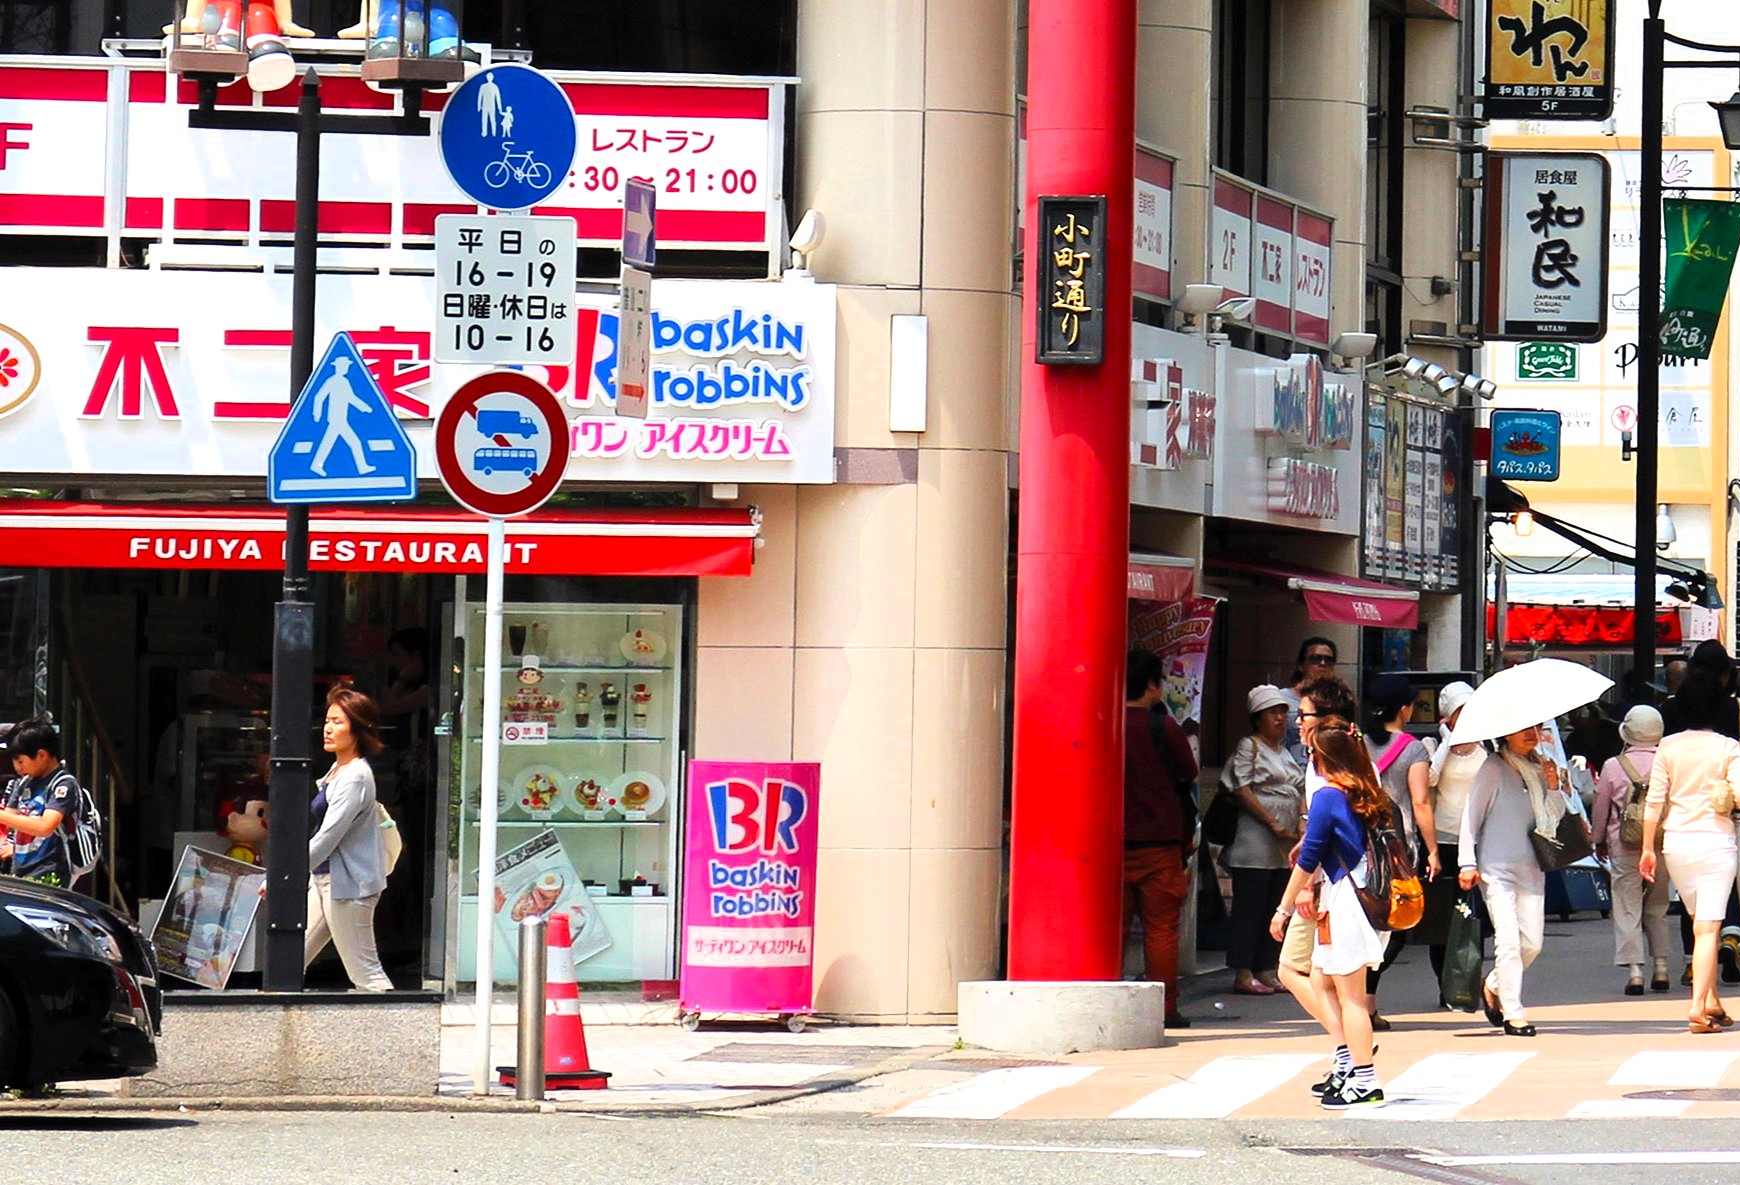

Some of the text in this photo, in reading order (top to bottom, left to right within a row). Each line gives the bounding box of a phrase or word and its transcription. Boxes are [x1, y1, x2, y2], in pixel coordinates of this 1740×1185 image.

[1498, 0, 1589, 83] わん
[1541, 100, 1558, 111] 5F
[592, 128, 715, 154] レストラン
[1535, 170, 1577, 185] 居食屋
[458, 228, 556, 255] 平日の
[1222, 228, 1237, 273] 2F
[1526, 189, 1585, 289] 和民
[1053, 212, 1092, 347] 小町通り
[651, 309, 804, 354] baskin
[655, 366, 804, 406] robbins
[643, 423, 790, 455] アイスクリーム
[128, 537, 538, 564] FUJIYA ESTAURAT
[711, 861, 798, 887] baskin
[713, 892, 800, 915] robbins
[749, 939, 806, 954] アイスクリーム
